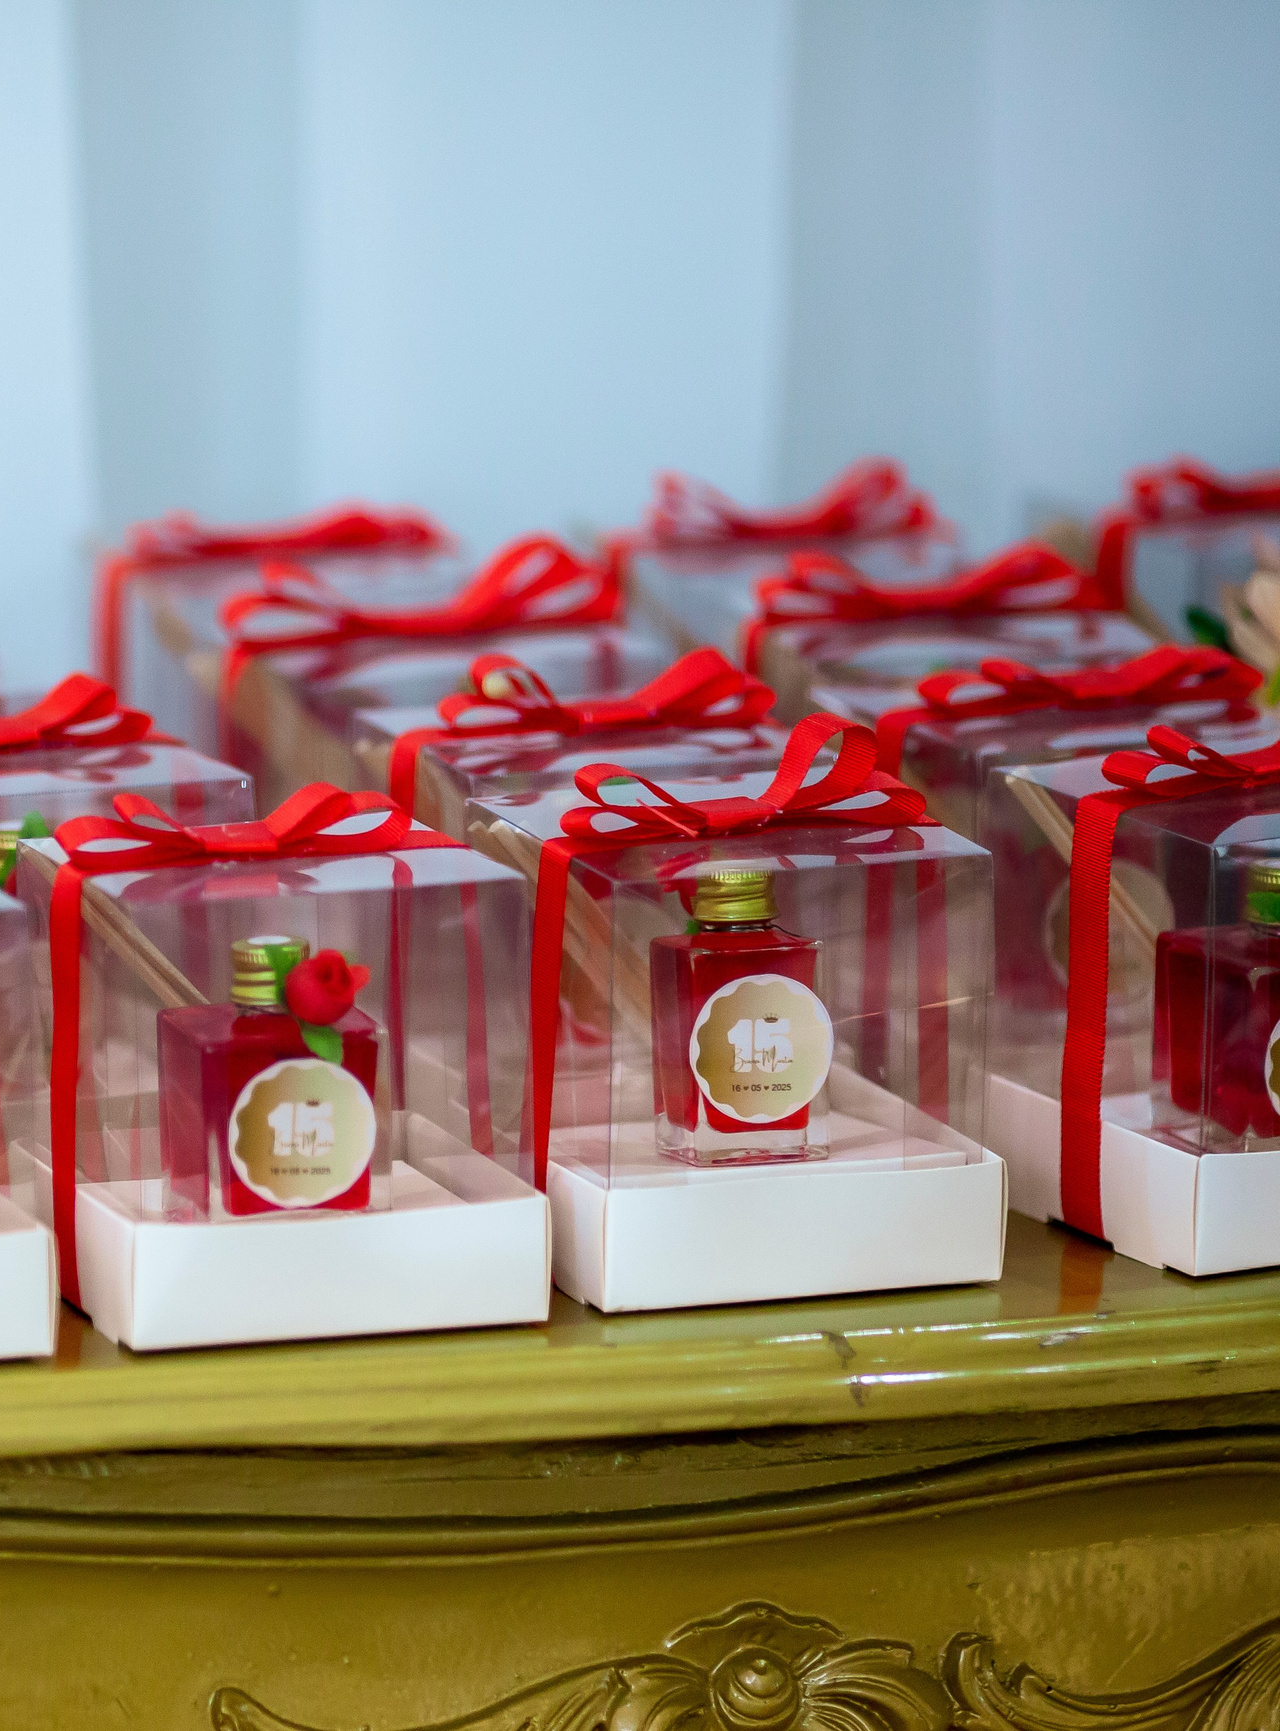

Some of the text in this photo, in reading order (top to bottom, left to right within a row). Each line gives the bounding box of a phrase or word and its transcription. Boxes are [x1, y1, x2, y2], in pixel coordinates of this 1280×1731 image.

[727, 1018, 793, 1073] 15
[732, 1083, 792, 1092] 16 05 2025
